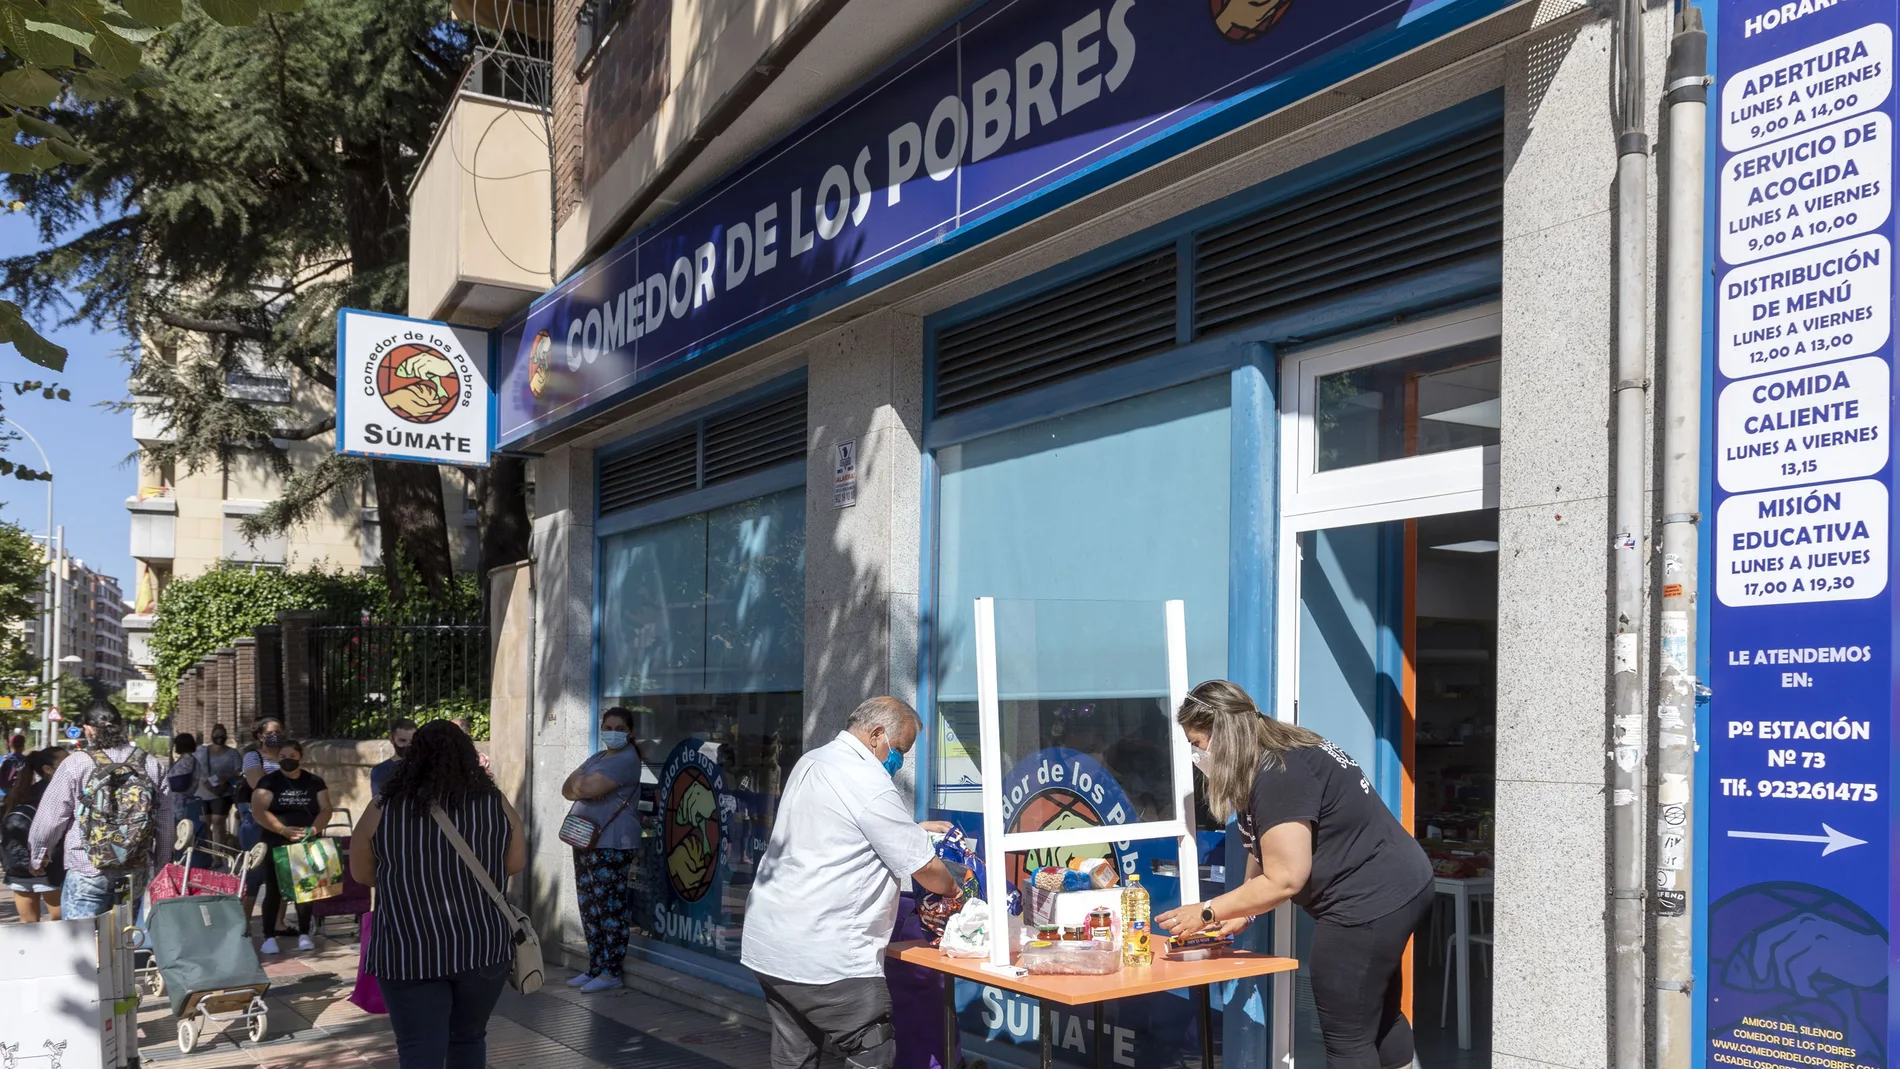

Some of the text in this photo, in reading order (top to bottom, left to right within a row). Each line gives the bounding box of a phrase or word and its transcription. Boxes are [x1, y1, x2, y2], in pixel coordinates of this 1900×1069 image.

[1742, 40, 1869, 100] APERTURA
[1731, 62, 1882, 124] LUNES A VIERNES
[1750, 94, 1858, 138] 9,00 A 14,00
[1733, 121, 1877, 182] SERVICIO DE
[565, 0, 1137, 374] COMEDOR DE LOS POBRES
[1748, 159, 1860, 206] ACOGIDA
[1729, 180, 1881, 234] LUNES A VIERNES
[1748, 212, 1858, 251] 9,00 A 10,00
[1728, 248, 1880, 299] DISTRIBUCIÓN
[1752, 279, 1851, 321] DE MENÚ
[1733, 306, 1873, 347] LUNES A VIERNES
[1749, 333, 1853, 363] 12,00 A 13,00
[364, 335, 398, 397] Comedor
[403, 330, 424, 341] de
[429, 334, 453, 353] los
[454, 354, 473, 408] Pobres
[1752, 370, 1850, 404] COMIDA
[1744, 399, 1859, 434] CALIENTE
[1727, 425, 1879, 461] LUNES A VIERNES
[1781, 459, 1817, 476] 13,15
[1758, 489, 1841, 519] MISIÓN
[1732, 520, 1870, 551] EDUCATIVA
[1731, 549, 1870, 575] LUNES A JUEVES
[1744, 576, 1855, 596] 17,00 A 19,30
[1729, 645, 1871, 666] LE ATENDEMOS
[1781, 672, 1813, 688] EN:
[1758, 716, 1870, 740] ESTACIÓN
[1801, 752, 1826, 768] 73
[1037, 759, 1064, 785] de
[1072, 761, 1105, 804] los
[1757, 780, 1878, 802] 923261475
[655, 757, 680, 854] Comedor
[682, 745, 695, 763] de
[698, 749, 714, 775] los
[1733, 1029, 1856, 1058] COMEDOR DE LOS POBRES
[1742, 1016, 1843, 1041] AMIGOS DEL SILENCIO
